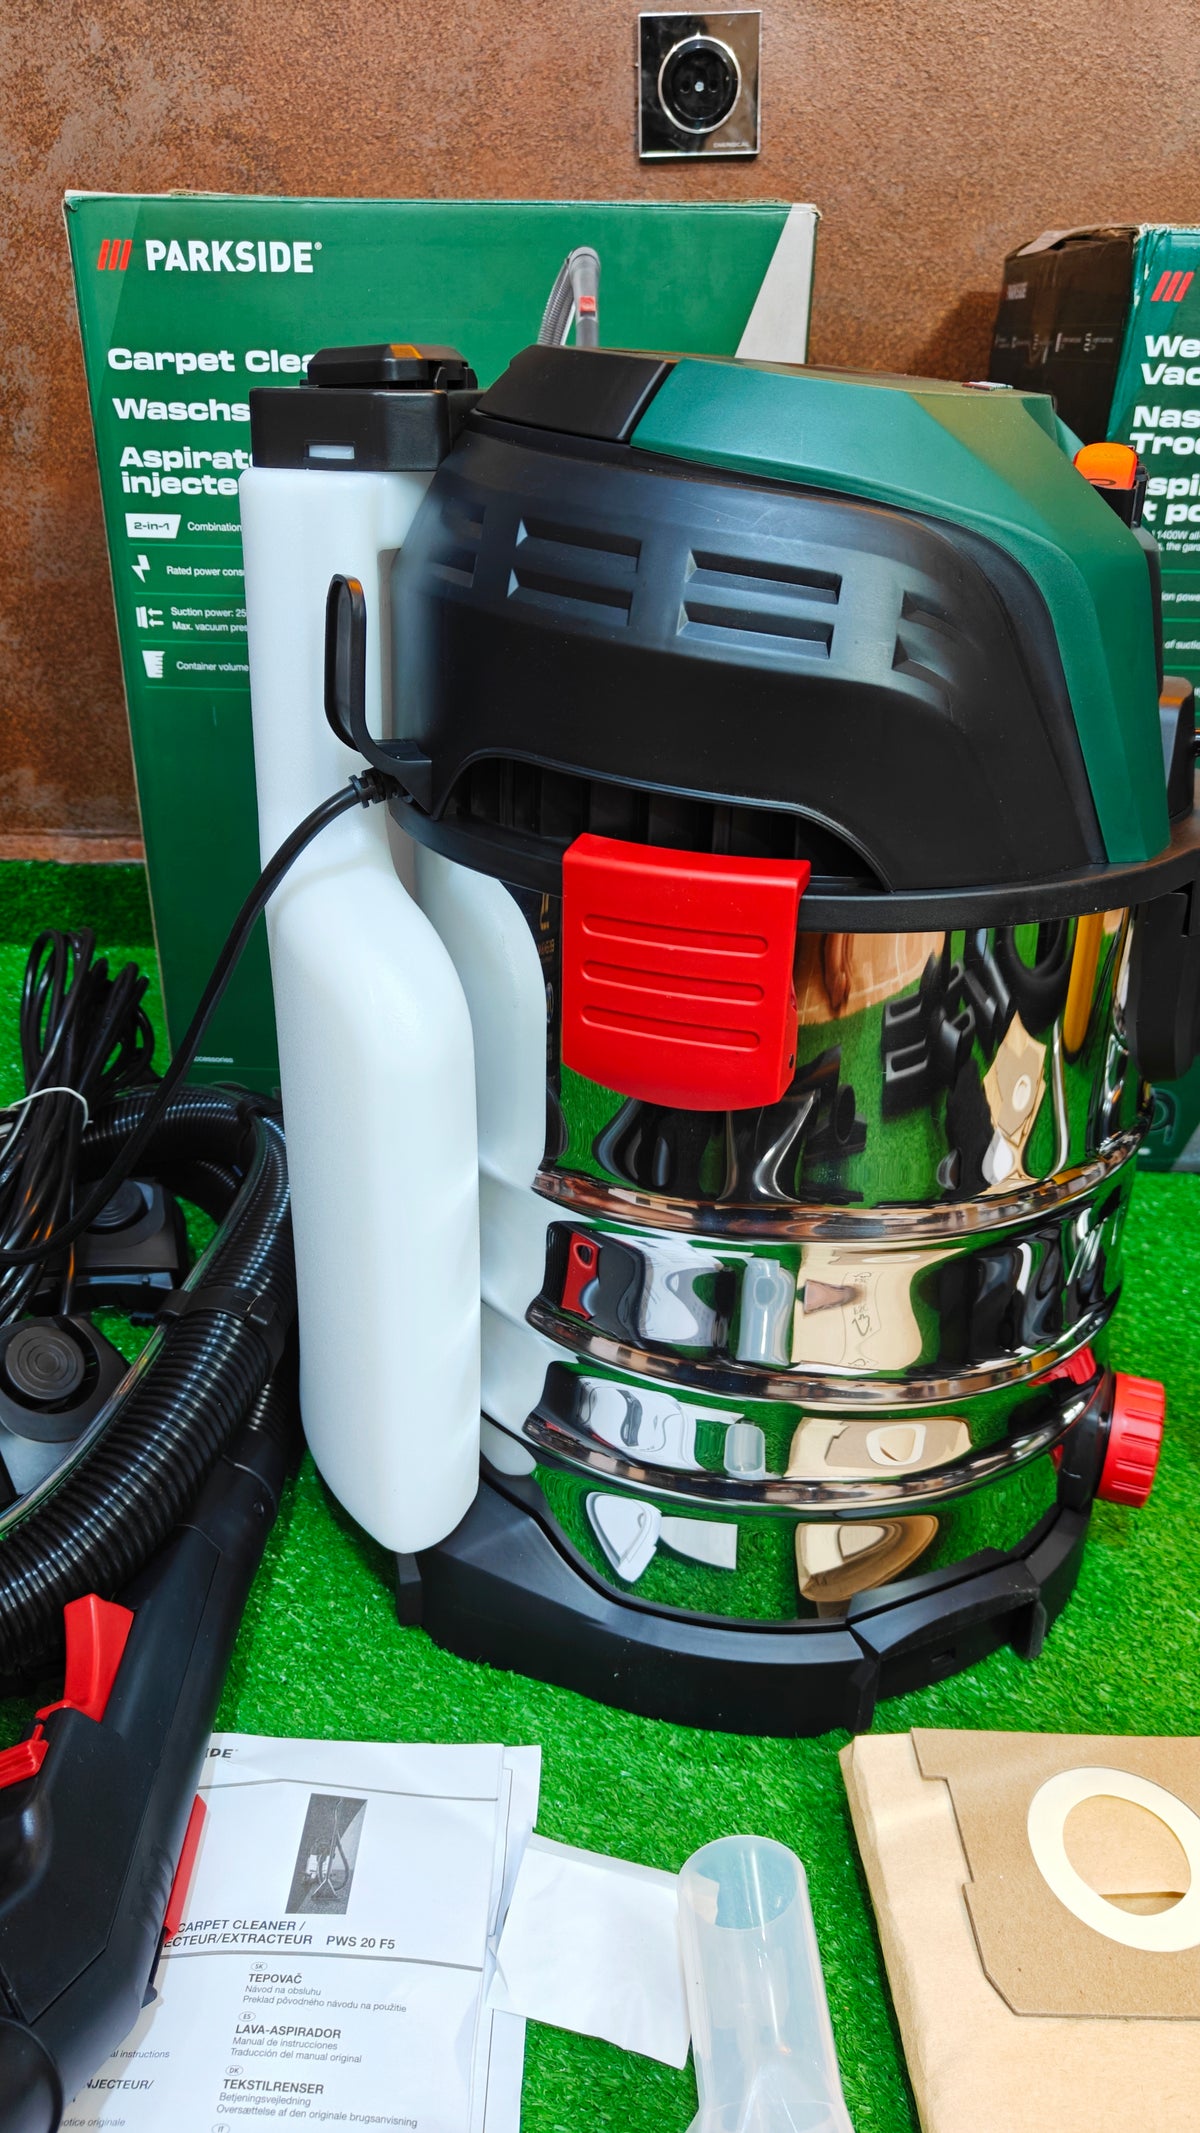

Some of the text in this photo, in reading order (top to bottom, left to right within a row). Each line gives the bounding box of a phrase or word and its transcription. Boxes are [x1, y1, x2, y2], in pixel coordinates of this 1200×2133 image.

[145, 240, 314, 273] PARKSIDE
[107, 348, 236, 375] Carpet
[112, 398, 250, 422] Waschs
[1129, 433, 1200, 456] Tro
[120, 446, 252, 472] Aspirat
[121, 471, 239, 498] injecte
[133, 521, 242, 532] 2-in-1 Combination
[166, 565, 192, 576] Rated
[194, 568, 221, 578] power
[170, 606, 203, 617] Suction
[204, 609, 234, 619] power:
[172, 621, 193, 631] Max.
[195, 623, 229, 632] vacuum
[176, 661, 249, 673] Container volume
[178, 1919, 229, 1933] CARPET
[232, 1919, 297, 1931] CLEANER
[326, 1935, 357, 1947] PWS
[360, 1937, 376, 1949] 20
[379, 1938, 396, 1950] F5
[254, 1963, 264, 1971] SK
[248, 1972, 303, 1985] TEPOVAČ
[245, 1984, 322, 1997] Návod na obsluhu
[243, 1995, 407, 2013] Preklad pôvodného návodu na použitie
[235, 2024, 342, 2039] LAVA-ASPIRADOR
[232, 2036, 338, 2051] Manual de instrucciones
[119, 2050, 170, 2059] instructions
[231, 2047, 363, 2065] Traducción del manual original
[229, 2067, 240, 2075] DK
[223, 2079, 325, 2095] TEKSTILRENSER
[219, 2092, 312, 2109] Betjeningsvejledning
[60, 2118, 86, 2127] otice
[216, 2104, 418, 2130] Oversættelse af den originale brugsanvisning
